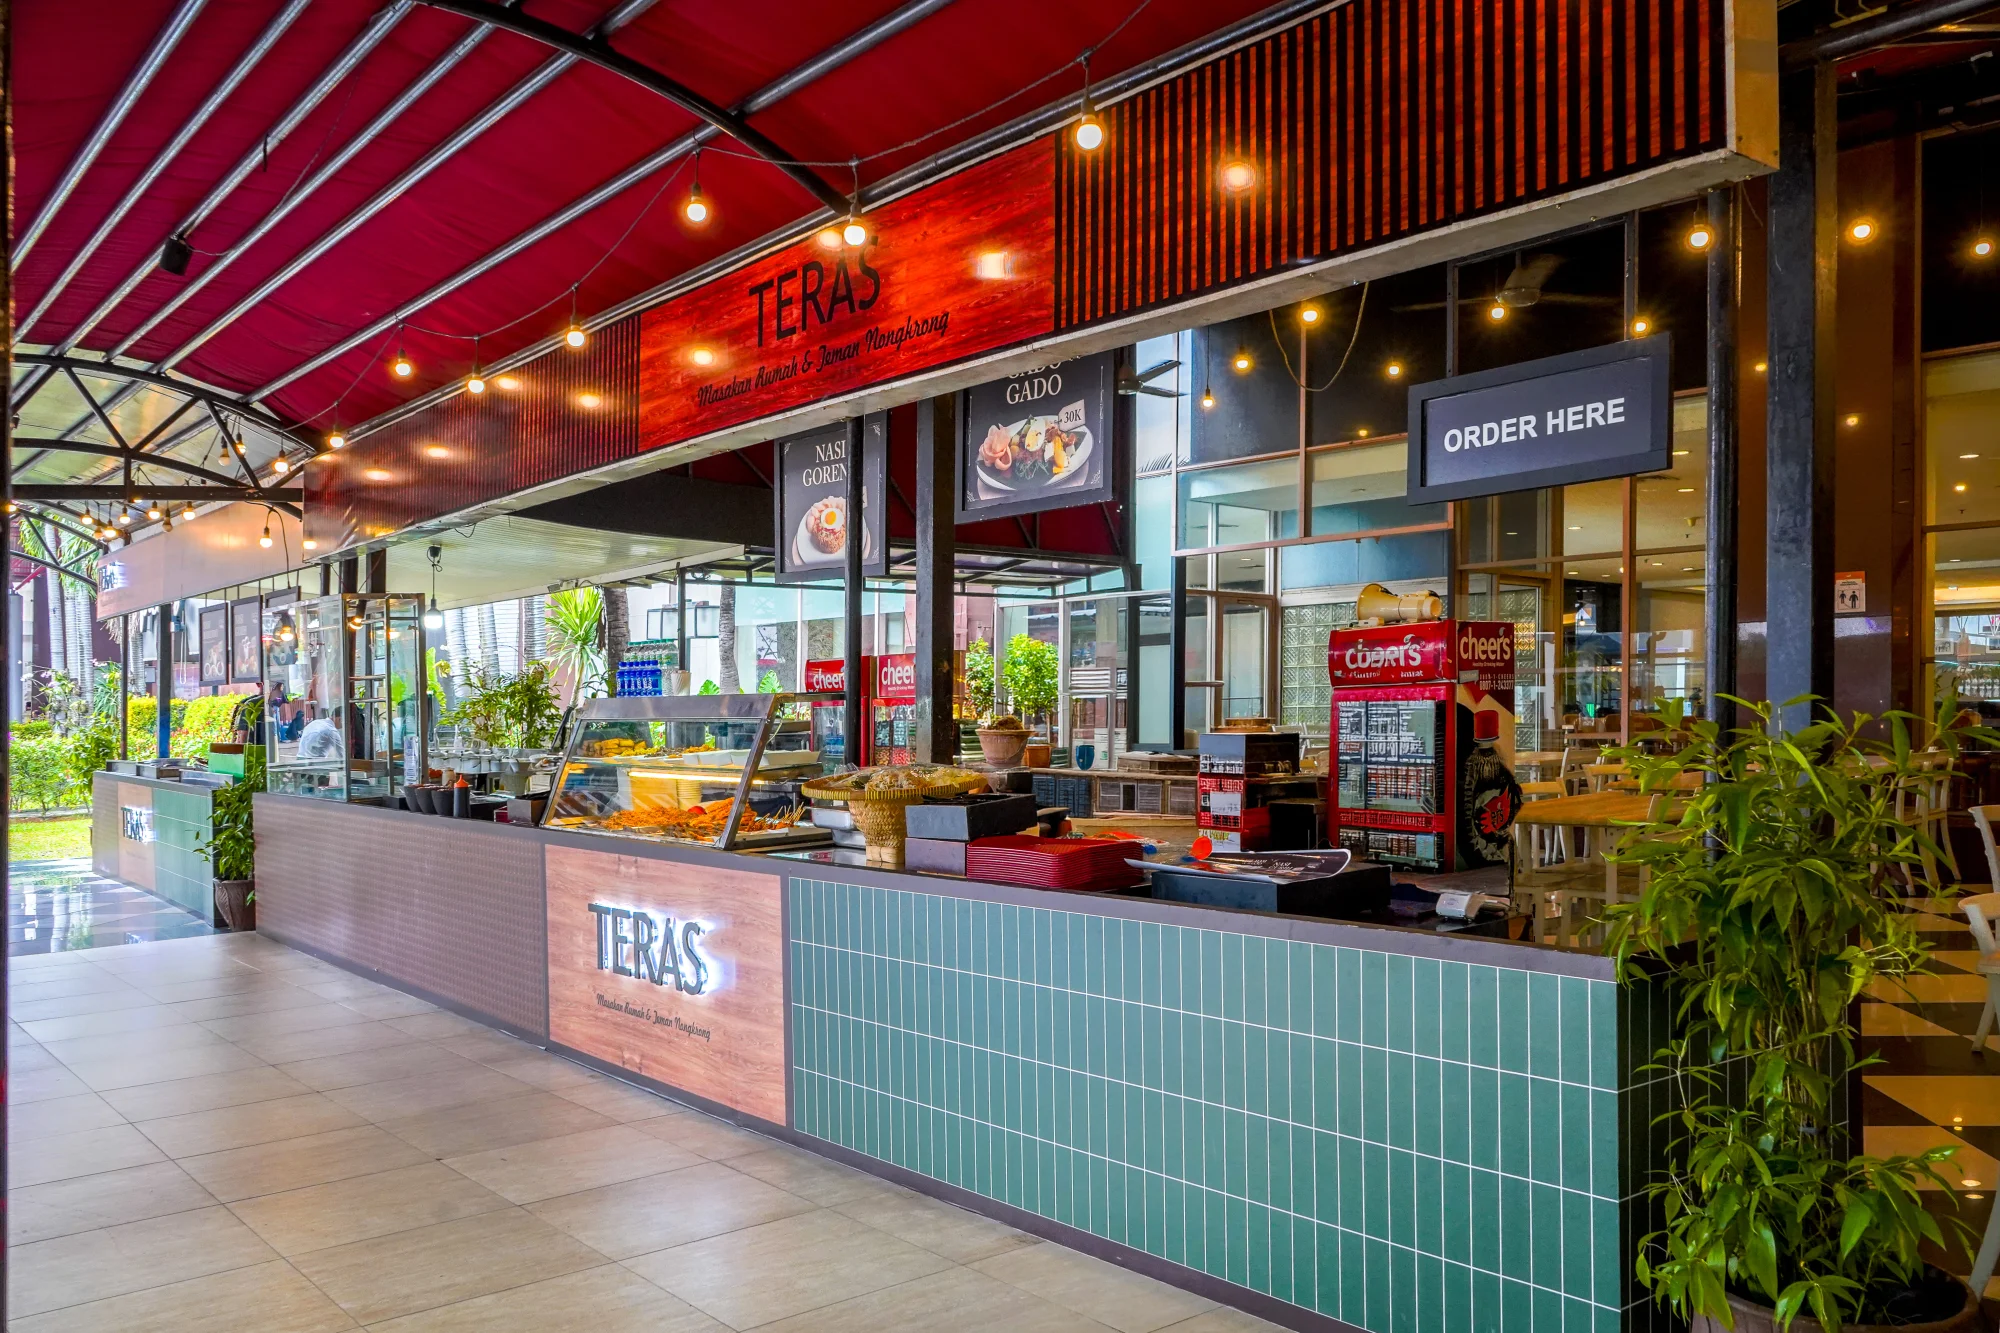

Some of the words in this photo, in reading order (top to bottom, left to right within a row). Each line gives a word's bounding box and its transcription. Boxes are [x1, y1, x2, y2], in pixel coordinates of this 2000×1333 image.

[749, 236, 880, 347] TERAS
[697, 375, 752, 408] Masakan
[755, 356, 798, 389] Rumah
[802, 350, 813, 373] &
[865, 311, 949, 353] Nongkrong
[1006, 374, 1062, 405] GADO
[1064, 408, 1082, 424] 30K
[1443, 414, 1538, 453] ORDER
[1547, 397, 1625, 436] HERE
[815, 440, 846, 463] NASI
[802, 463, 847, 487] GOREN
[813, 668, 845, 689] cheer
[881, 659, 916, 686] cheer
[588, 903, 706, 995] TERAS
[597, 993, 623, 1012] Masakan
[624, 1002, 645, 1019] Rumah
[645, 1009, 652, 1021] &
[675, 1016, 711, 1042] Nongkrong
